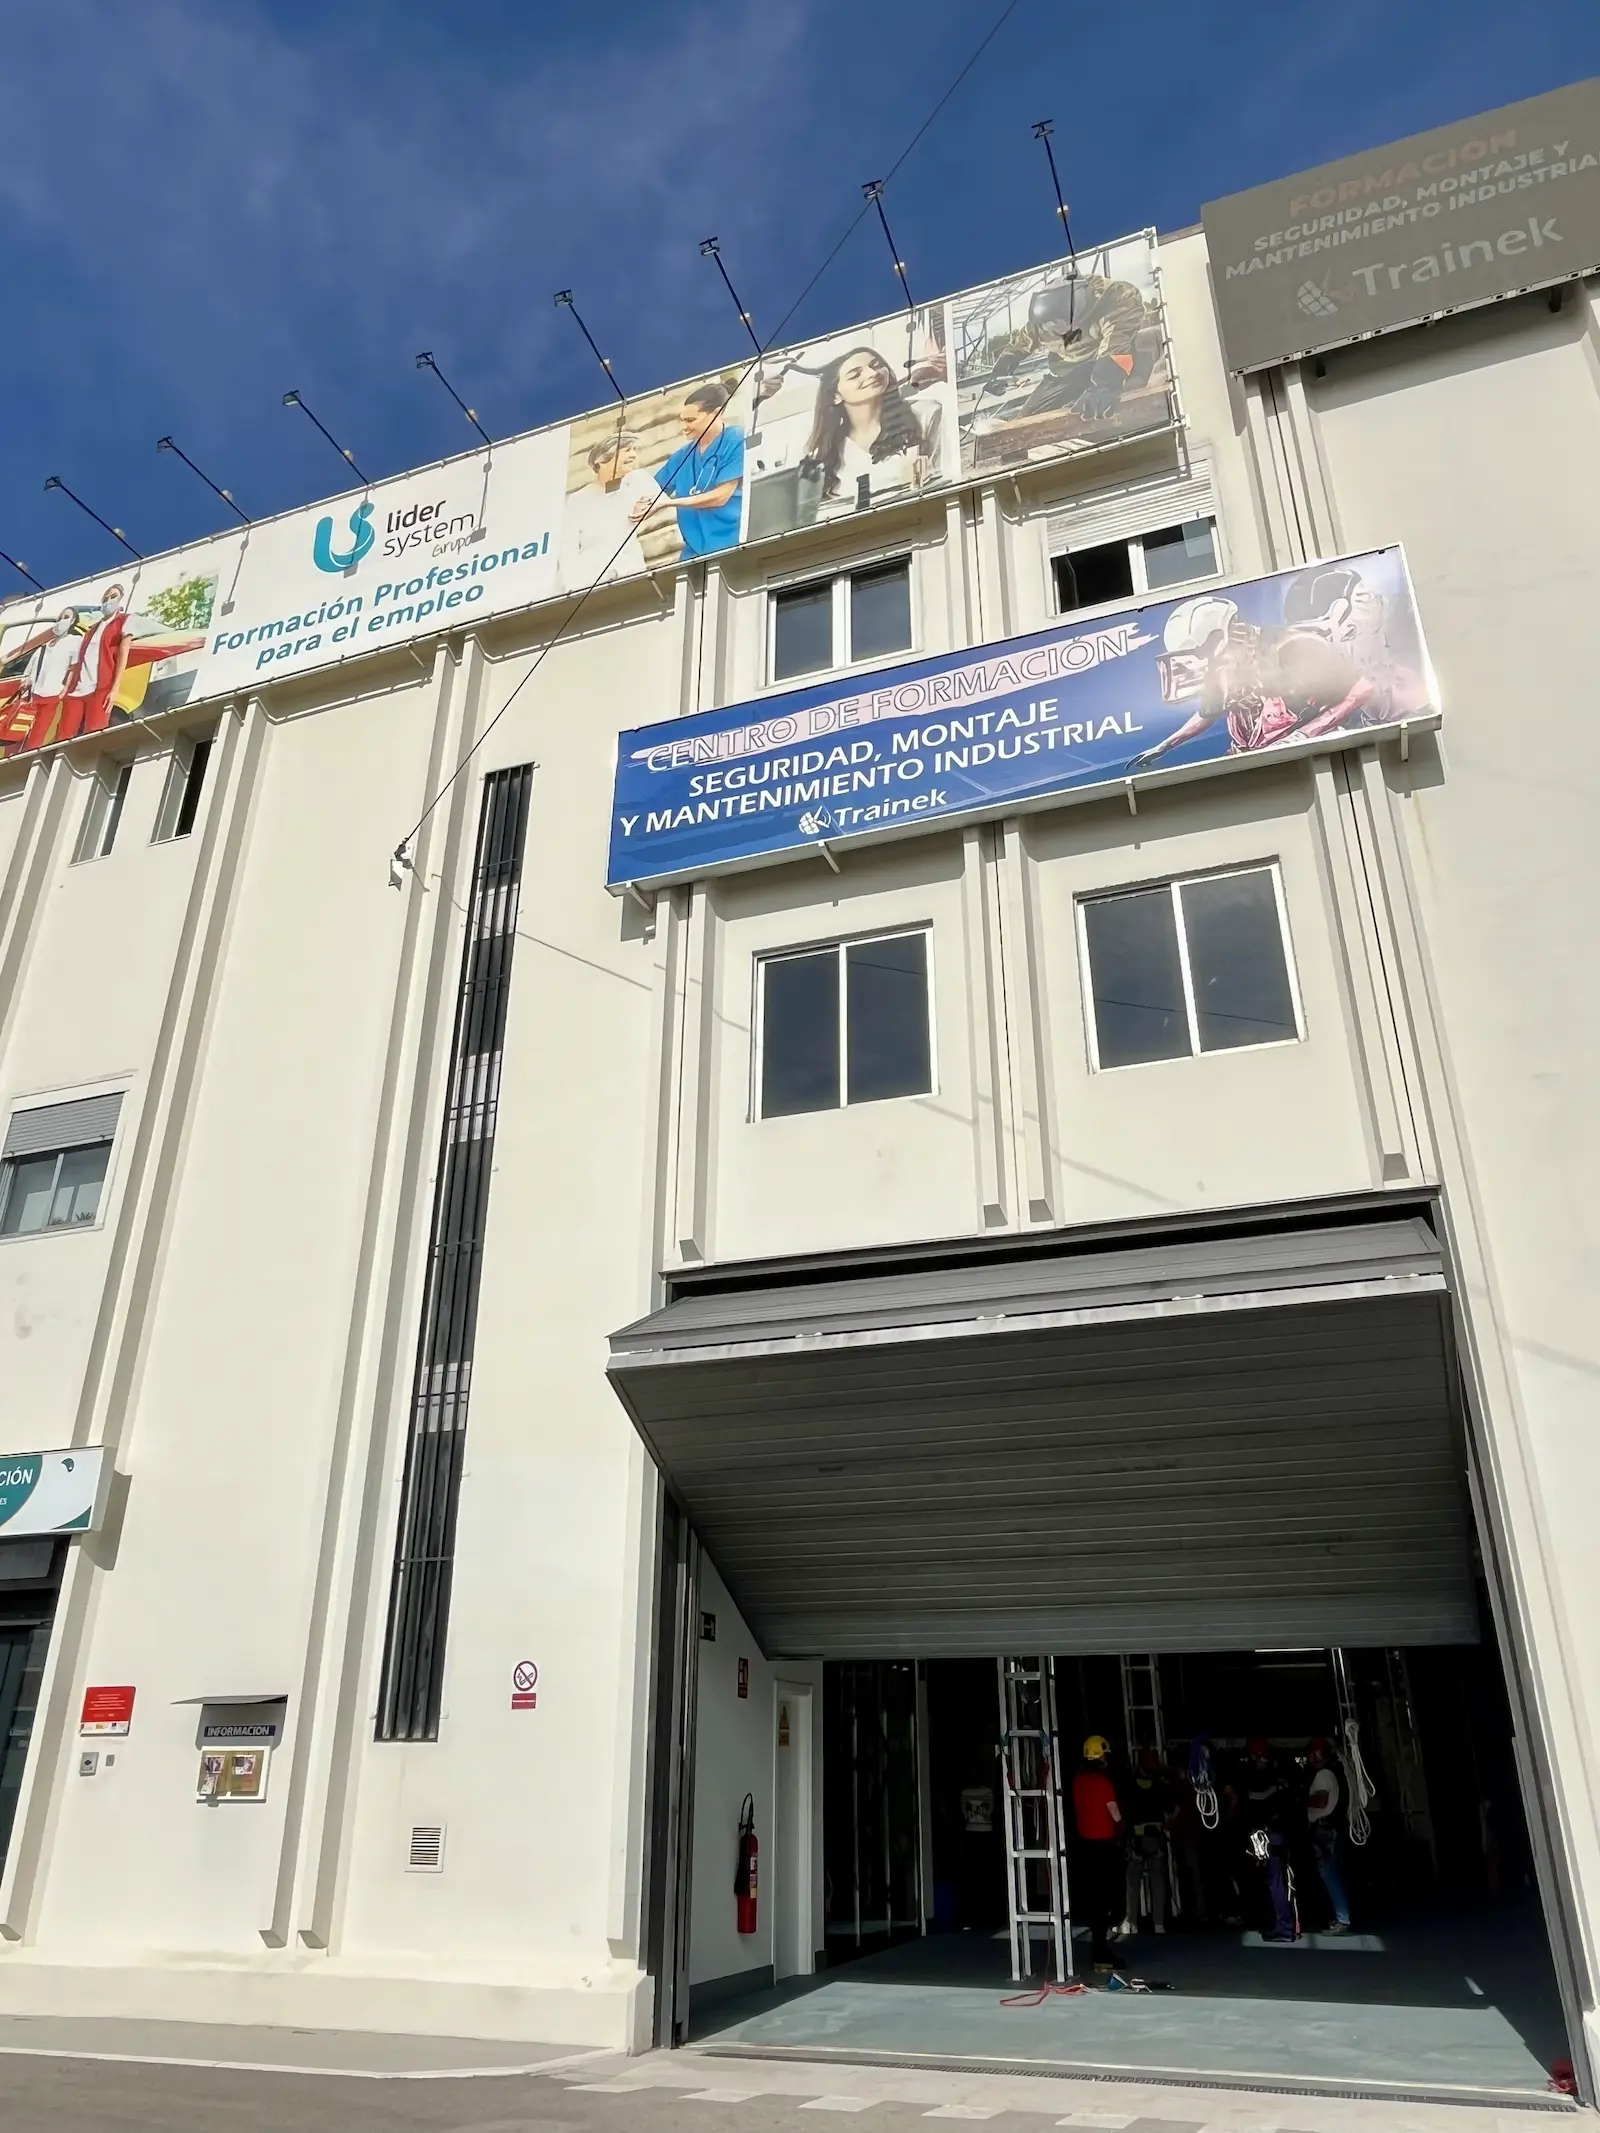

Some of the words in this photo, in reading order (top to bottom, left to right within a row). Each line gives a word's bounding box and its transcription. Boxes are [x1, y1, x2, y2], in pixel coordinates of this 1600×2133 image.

[1225, 202, 1442, 280] MANTENIMIENTO
[1450, 150, 1600, 211] INDUSTRIA
[1254, 194, 1408, 251] SEGURIDAD,
[1416, 148, 1545, 201] MONTAJE
[1553, 140, 1569, 157] Y
[1289, 130, 1516, 219] FORMACIÓN
[1352, 217, 1564, 296] Trainek
[383, 513, 474, 557] system
[387, 500, 446, 533] lider
[212, 596, 363, 655] Formación
[374, 532, 550, 606] Profesional
[256, 634, 321, 670] para
[332, 617, 359, 643] el
[368, 585, 484, 632] empleo
[647, 717, 798, 772] CENTRO
[808, 698, 860, 735] DE
[872, 629, 1129, 720] FORMACIÓN
[620, 814, 640, 837] Y
[645, 758, 924, 833] MANTENIMIENTO
[934, 711, 1144, 773] INDUSTRIAL
[689, 740, 882, 798] SEGURIDAD,
[892, 698, 1059, 755] MONTAJE
[833, 788, 948, 828] Trainek
